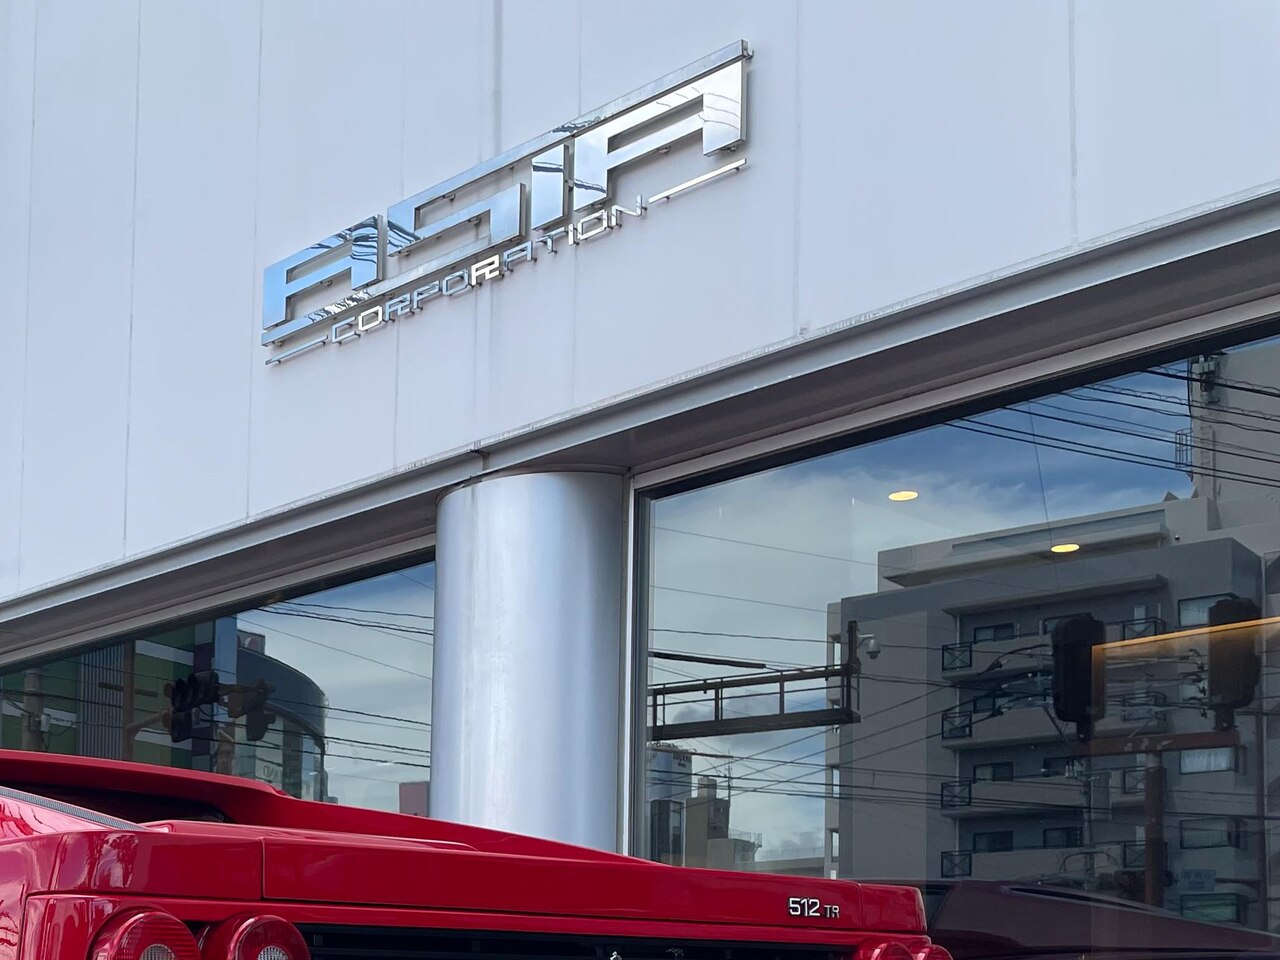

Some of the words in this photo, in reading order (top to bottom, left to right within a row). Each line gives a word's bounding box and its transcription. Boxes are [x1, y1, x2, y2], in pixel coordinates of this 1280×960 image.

[261, 39, 747, 346] ASIA
[331, 195, 646, 345] CORPORATION
[788, 897, 820, 917] 512
[823, 904, 840, 918] TR
